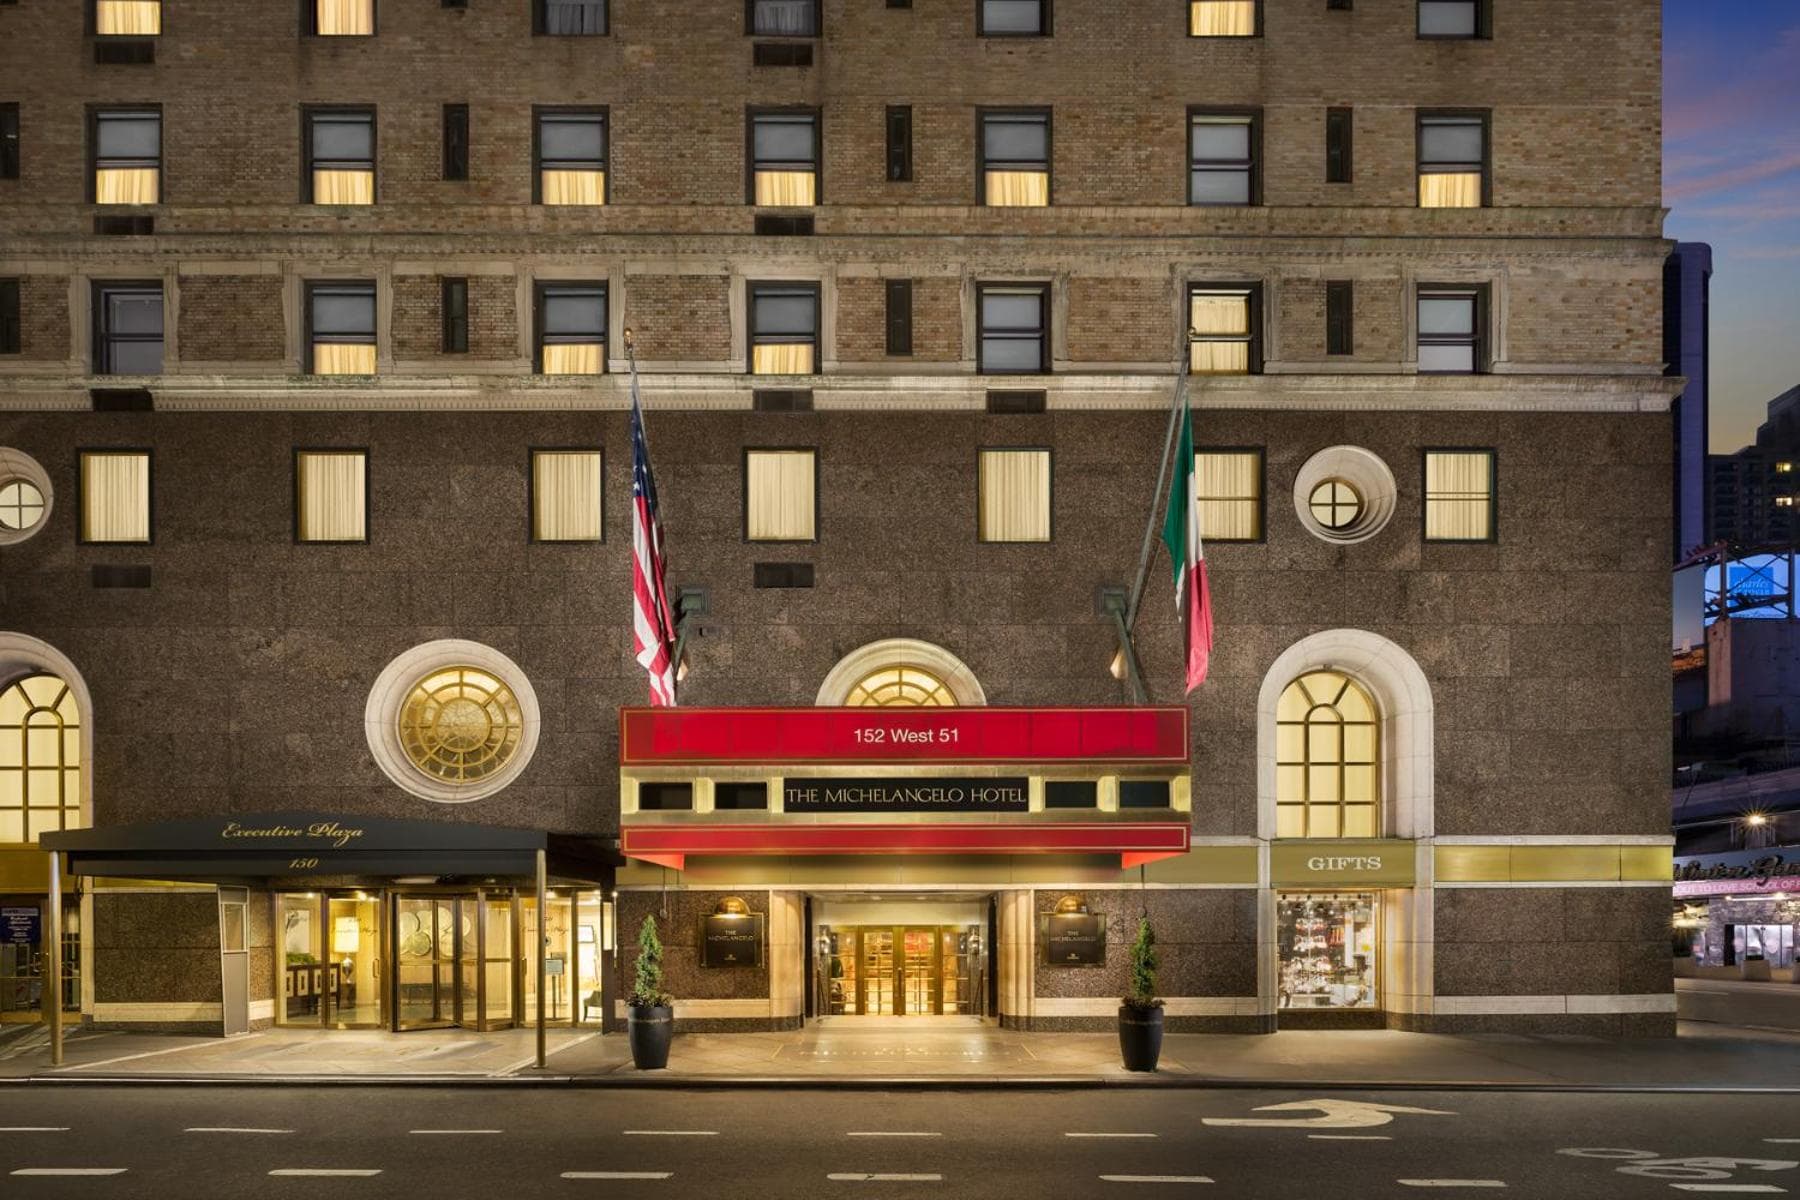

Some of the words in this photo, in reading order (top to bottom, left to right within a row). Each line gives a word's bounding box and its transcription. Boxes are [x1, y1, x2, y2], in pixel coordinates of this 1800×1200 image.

[854, 729, 885, 743] 152
[891, 729, 933, 743] West
[939, 728, 959, 743] 51
[786, 789, 818, 803] THE
[824, 788, 965, 803] MICHELANGELO
[972, 788, 1026, 802] HOTEL
[222, 821, 302, 838] Executive
[306, 822, 364, 848] Plaza
[289, 857, 320, 869] 150
[1307, 856, 1382, 871] GIFTS
